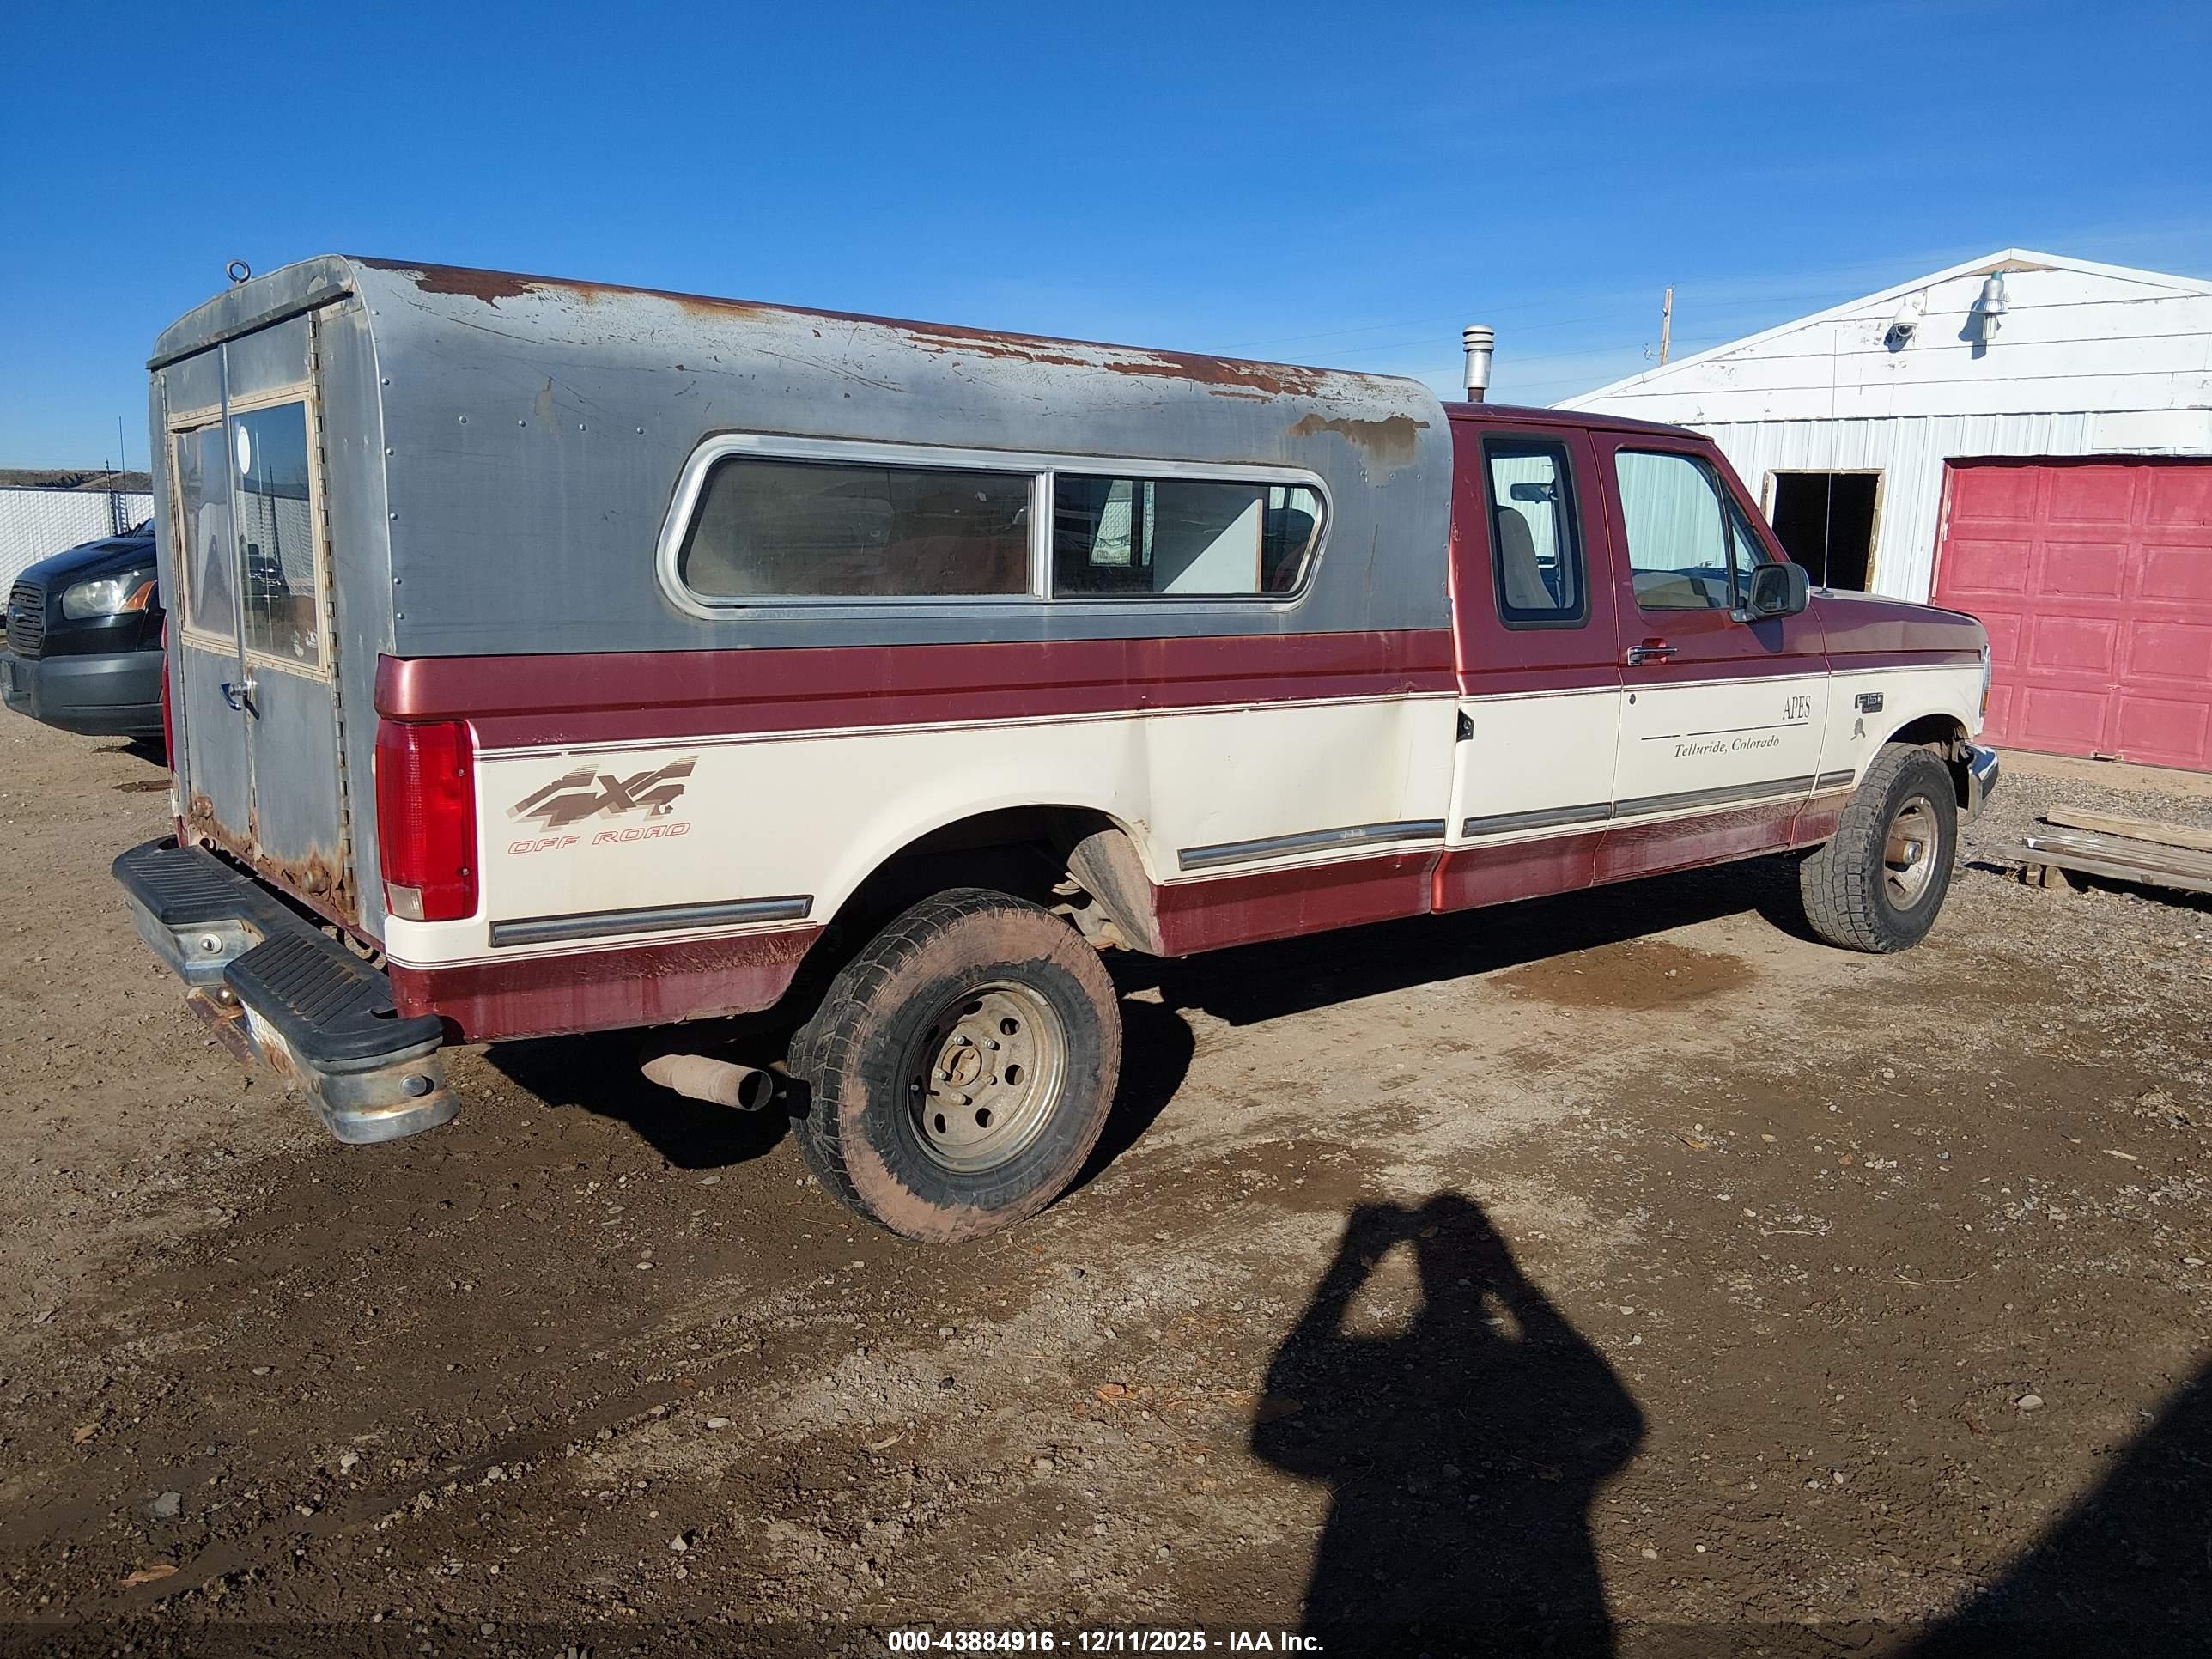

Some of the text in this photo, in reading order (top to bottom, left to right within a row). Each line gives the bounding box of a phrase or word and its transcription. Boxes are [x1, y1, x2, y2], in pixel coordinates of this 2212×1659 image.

[1782, 695, 1811, 720] APES
[1674, 735, 1780, 757] Telluride, Colorado
[507, 823, 690, 855] OFF ROAD
